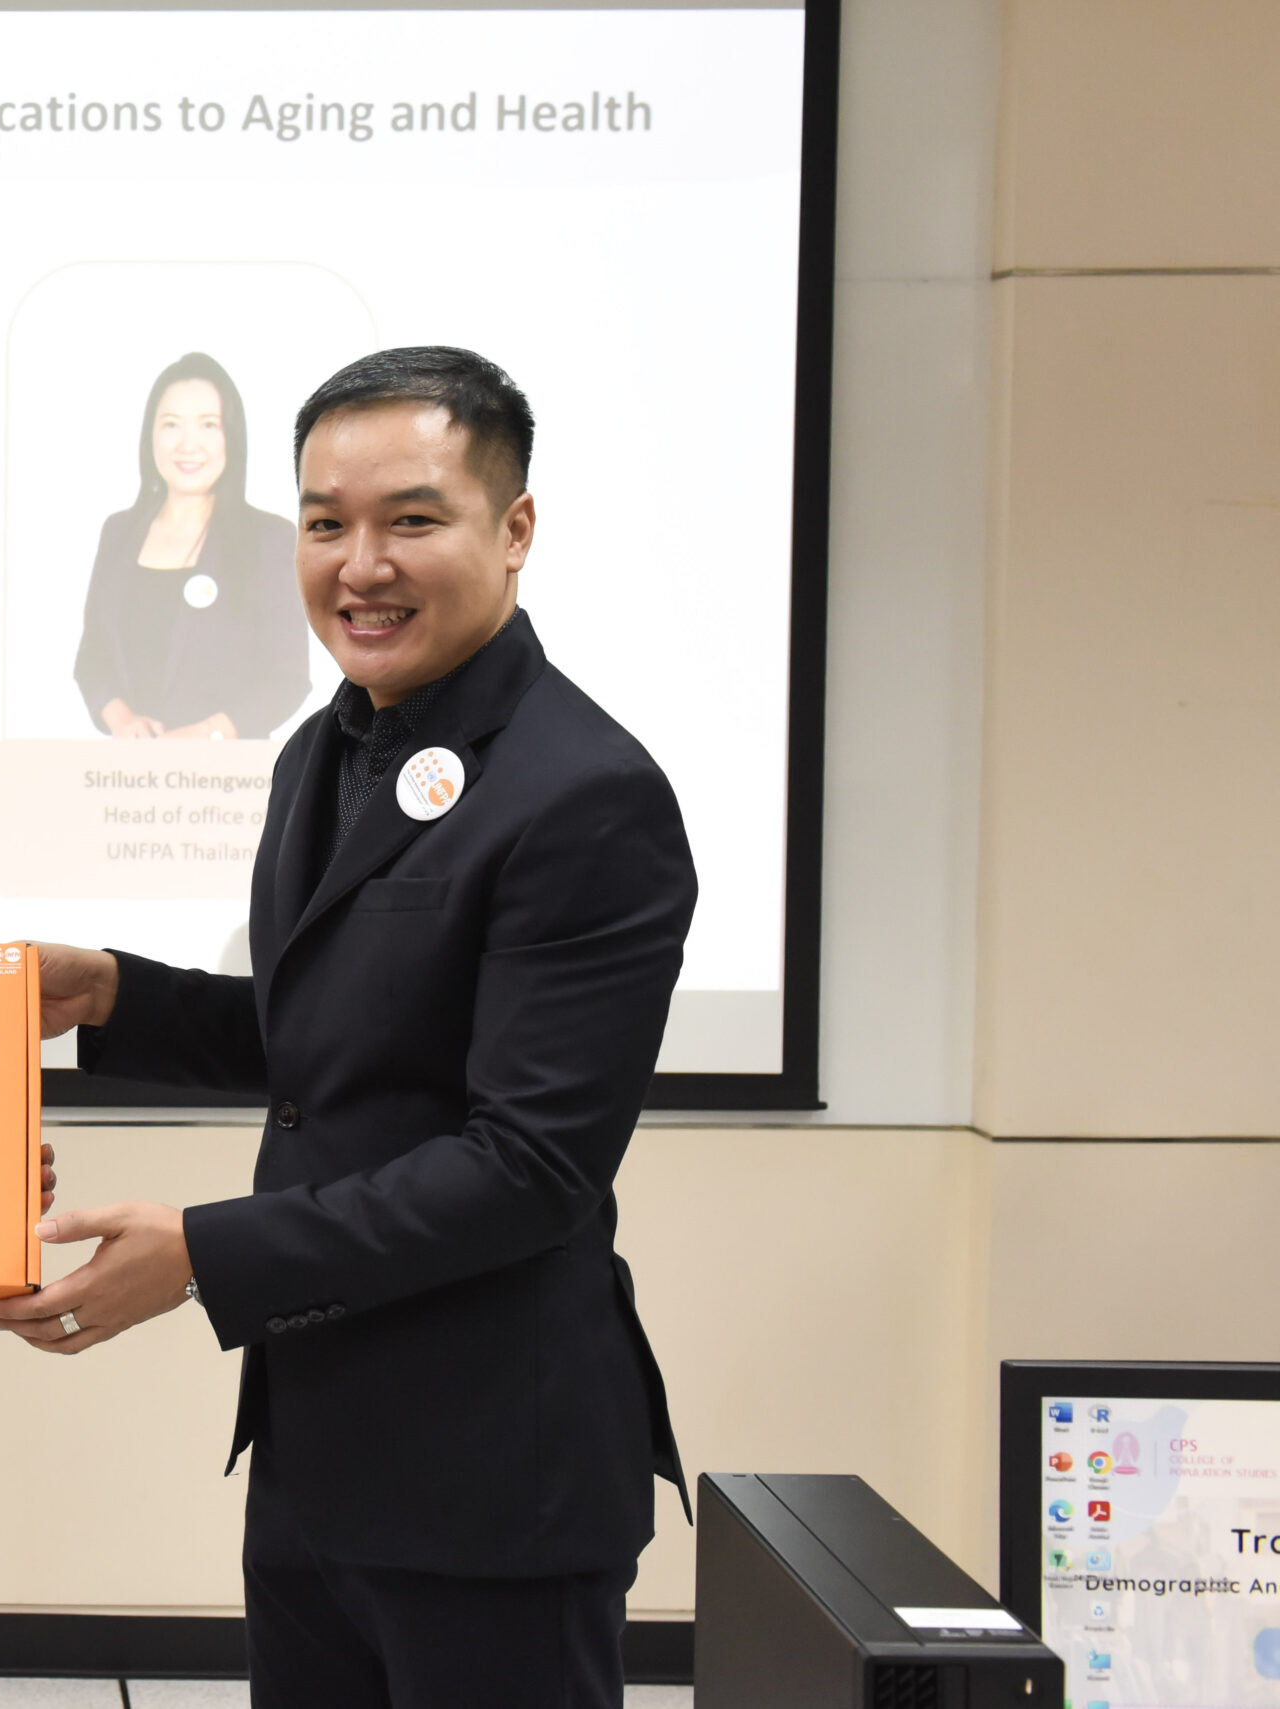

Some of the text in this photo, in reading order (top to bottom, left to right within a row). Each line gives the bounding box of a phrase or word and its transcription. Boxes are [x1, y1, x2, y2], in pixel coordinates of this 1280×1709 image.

[178, 96, 226, 133] to
[242, 92, 375, 143] Aging
[391, 91, 477, 133] and
[496, 91, 652, 133] Health
[84, 769, 159, 789] Siriluck
[104, 806, 267, 825] Head of office o
[107, 842, 257, 862] UNFPA Thailan
[1169, 1438, 1198, 1452] CPS
[1169, 1455, 1215, 1464] COLLEGE
[1236, 1468, 1278, 1478] STUDIES
[1086, 1574, 1240, 1597] Demographic
